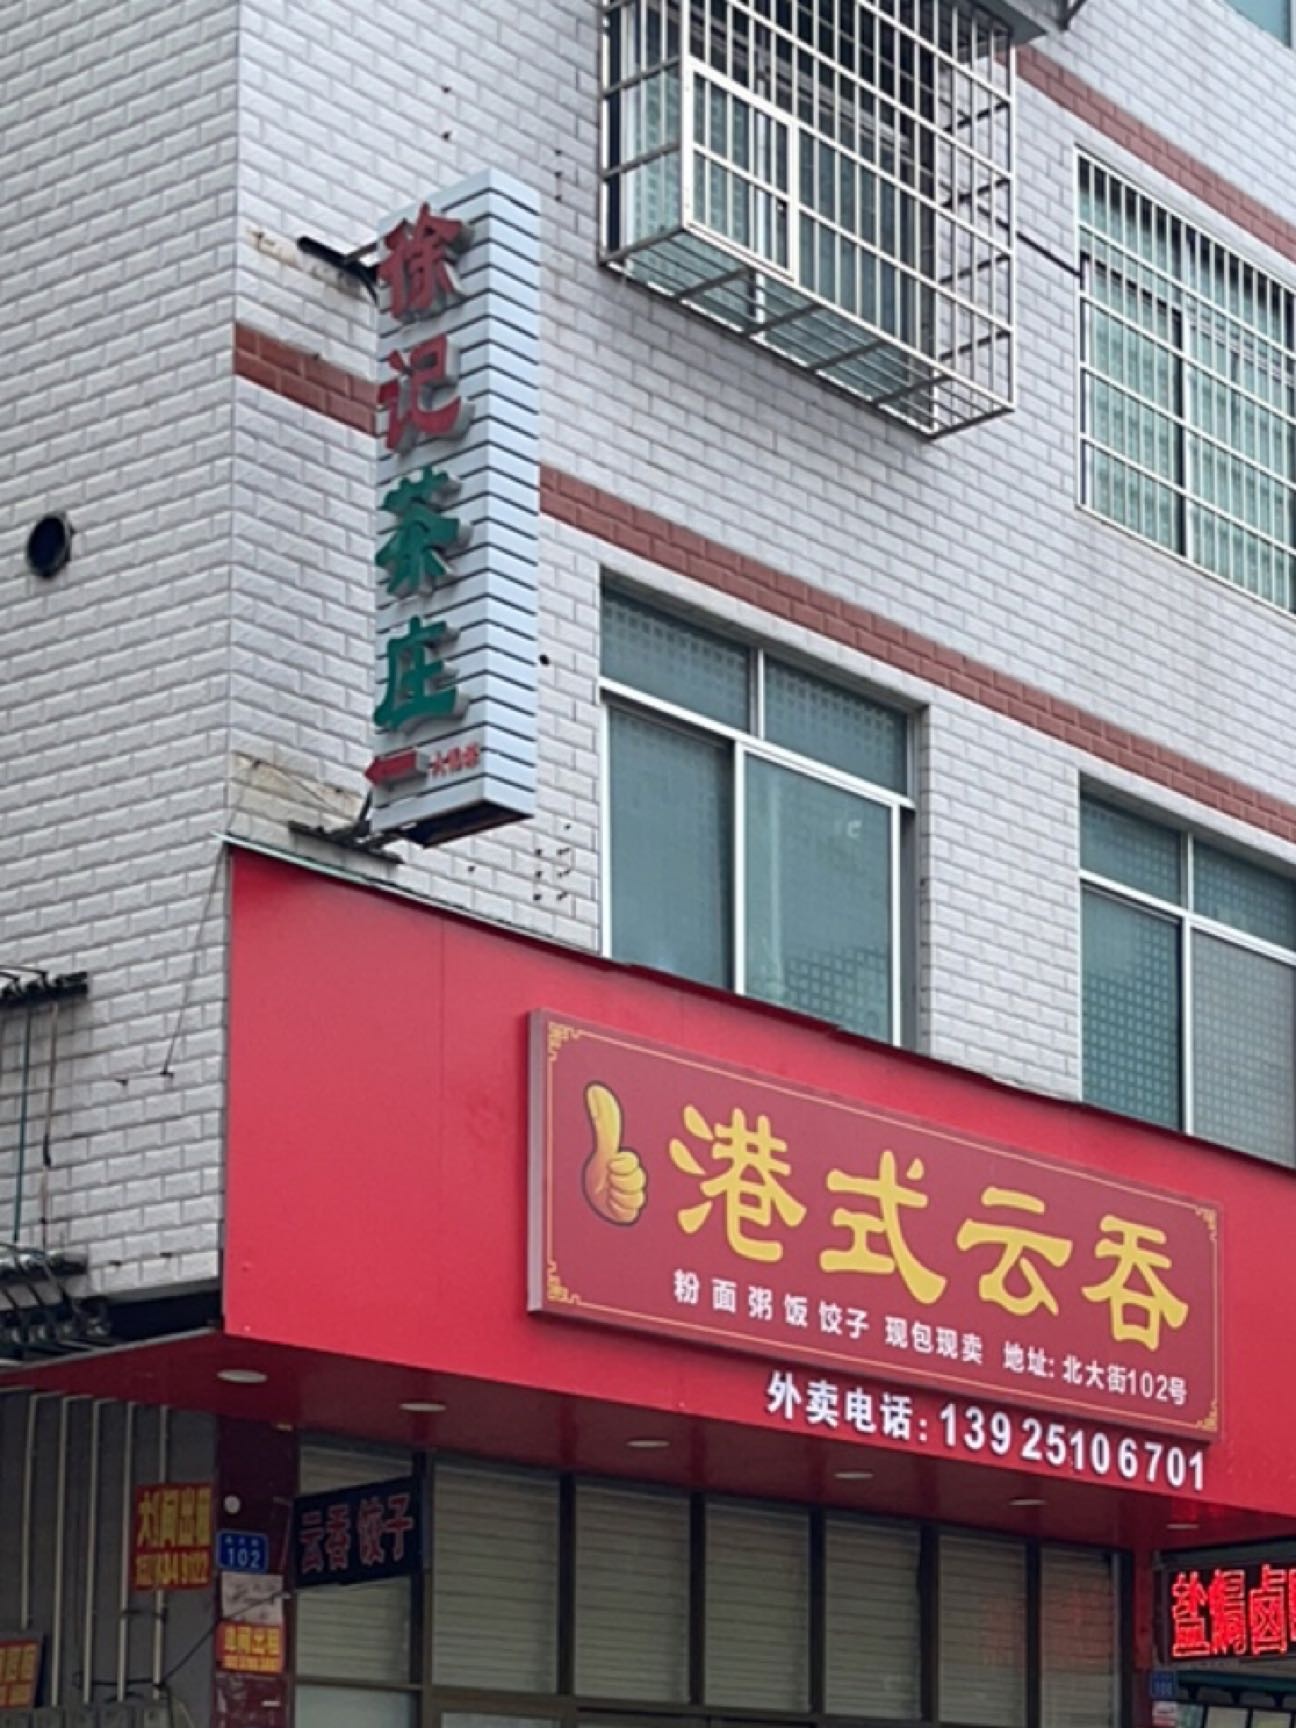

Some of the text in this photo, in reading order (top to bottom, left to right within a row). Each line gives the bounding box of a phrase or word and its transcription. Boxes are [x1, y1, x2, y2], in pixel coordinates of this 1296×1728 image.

[374, 203, 464, 732] 徐记茶庄
[668, 1103, 1189, 1350] 港式云吞
[674, 1268, 700, 1305] 粉
[712, 1278, 737, 1313] 面
[748, 1286, 772, 1321] 粥
[784, 1293, 808, 1328] 饭
[819, 1300, 869, 1339] 饺子
[885, 1316, 984, 1365] 现包现卖
[227, 1547, 261, 1569] 102
